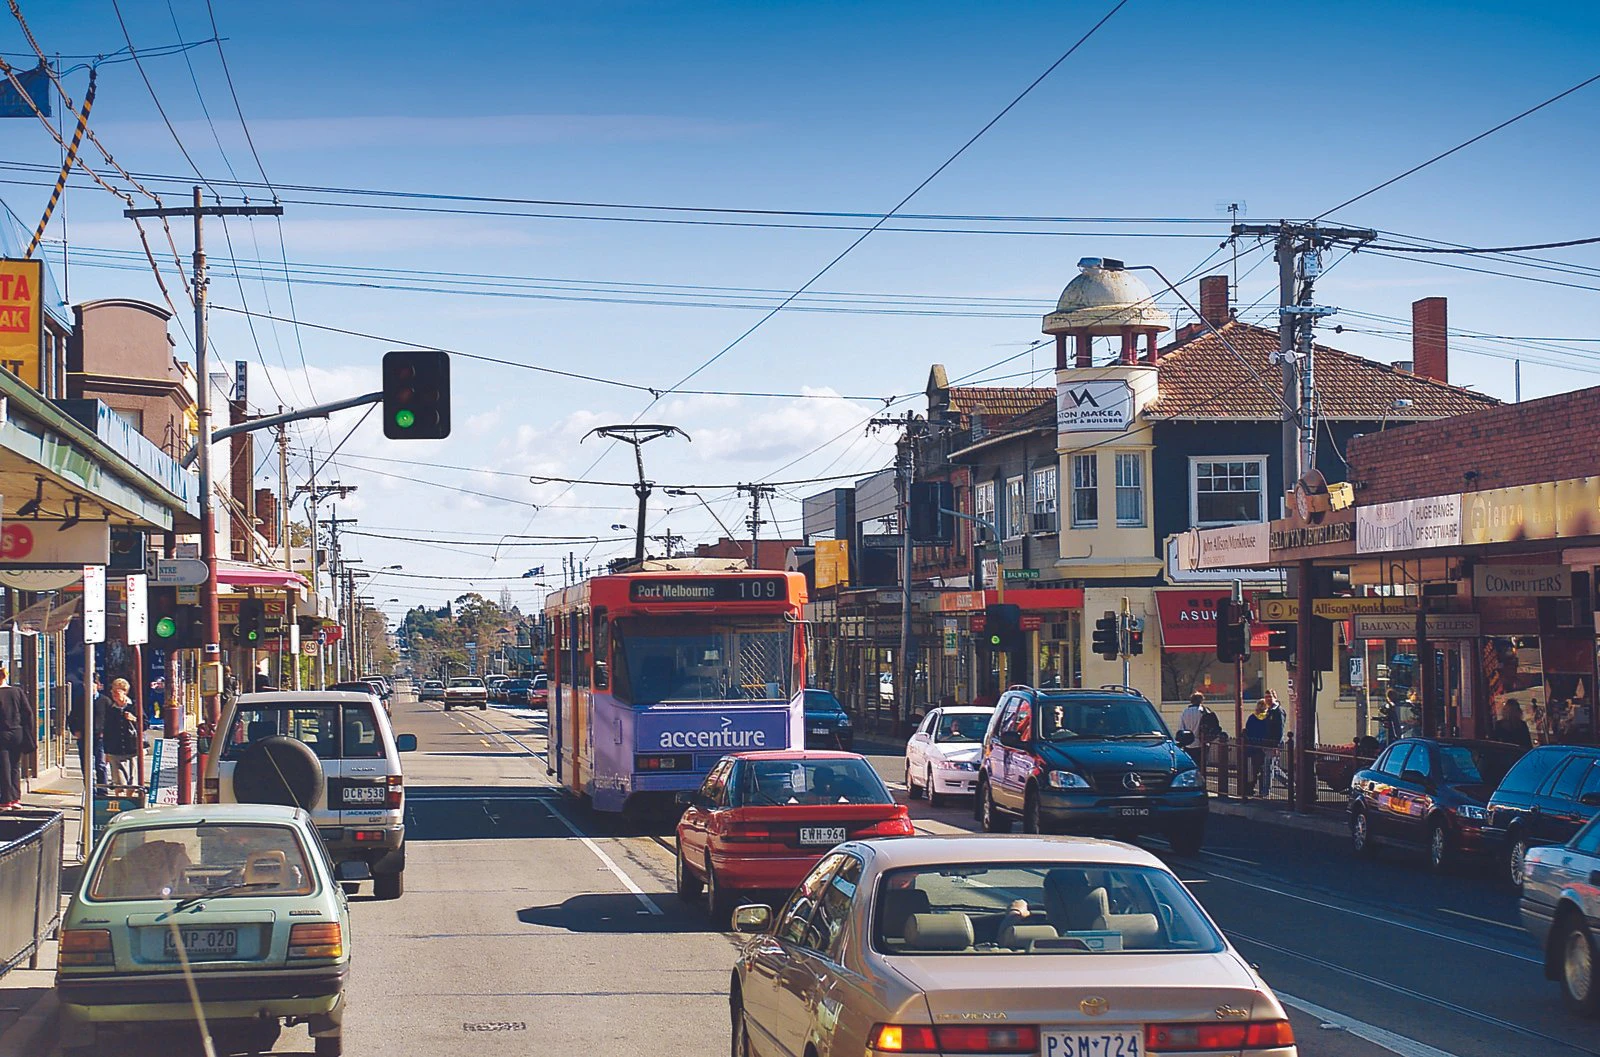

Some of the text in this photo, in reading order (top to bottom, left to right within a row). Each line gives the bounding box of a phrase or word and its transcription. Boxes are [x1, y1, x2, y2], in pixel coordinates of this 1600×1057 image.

[1080, 410, 1122, 418] MAKEA
[1415, 503, 1454, 521] HUGE RANGE
[1303, 522, 1351, 546] JEWELLERS
[1359, 509, 1414, 551] COMPUTERS
[1416, 523, 1458, 541] OF SOFTWARE
[637, 581, 776, 598] Port Melbourne 109
[1485, 573, 1562, 593] COMPUTERS
[1361, 621, 1410, 631] BALWYN
[306, 643, 315, 651] 60
[660, 726, 765, 748] accenture
